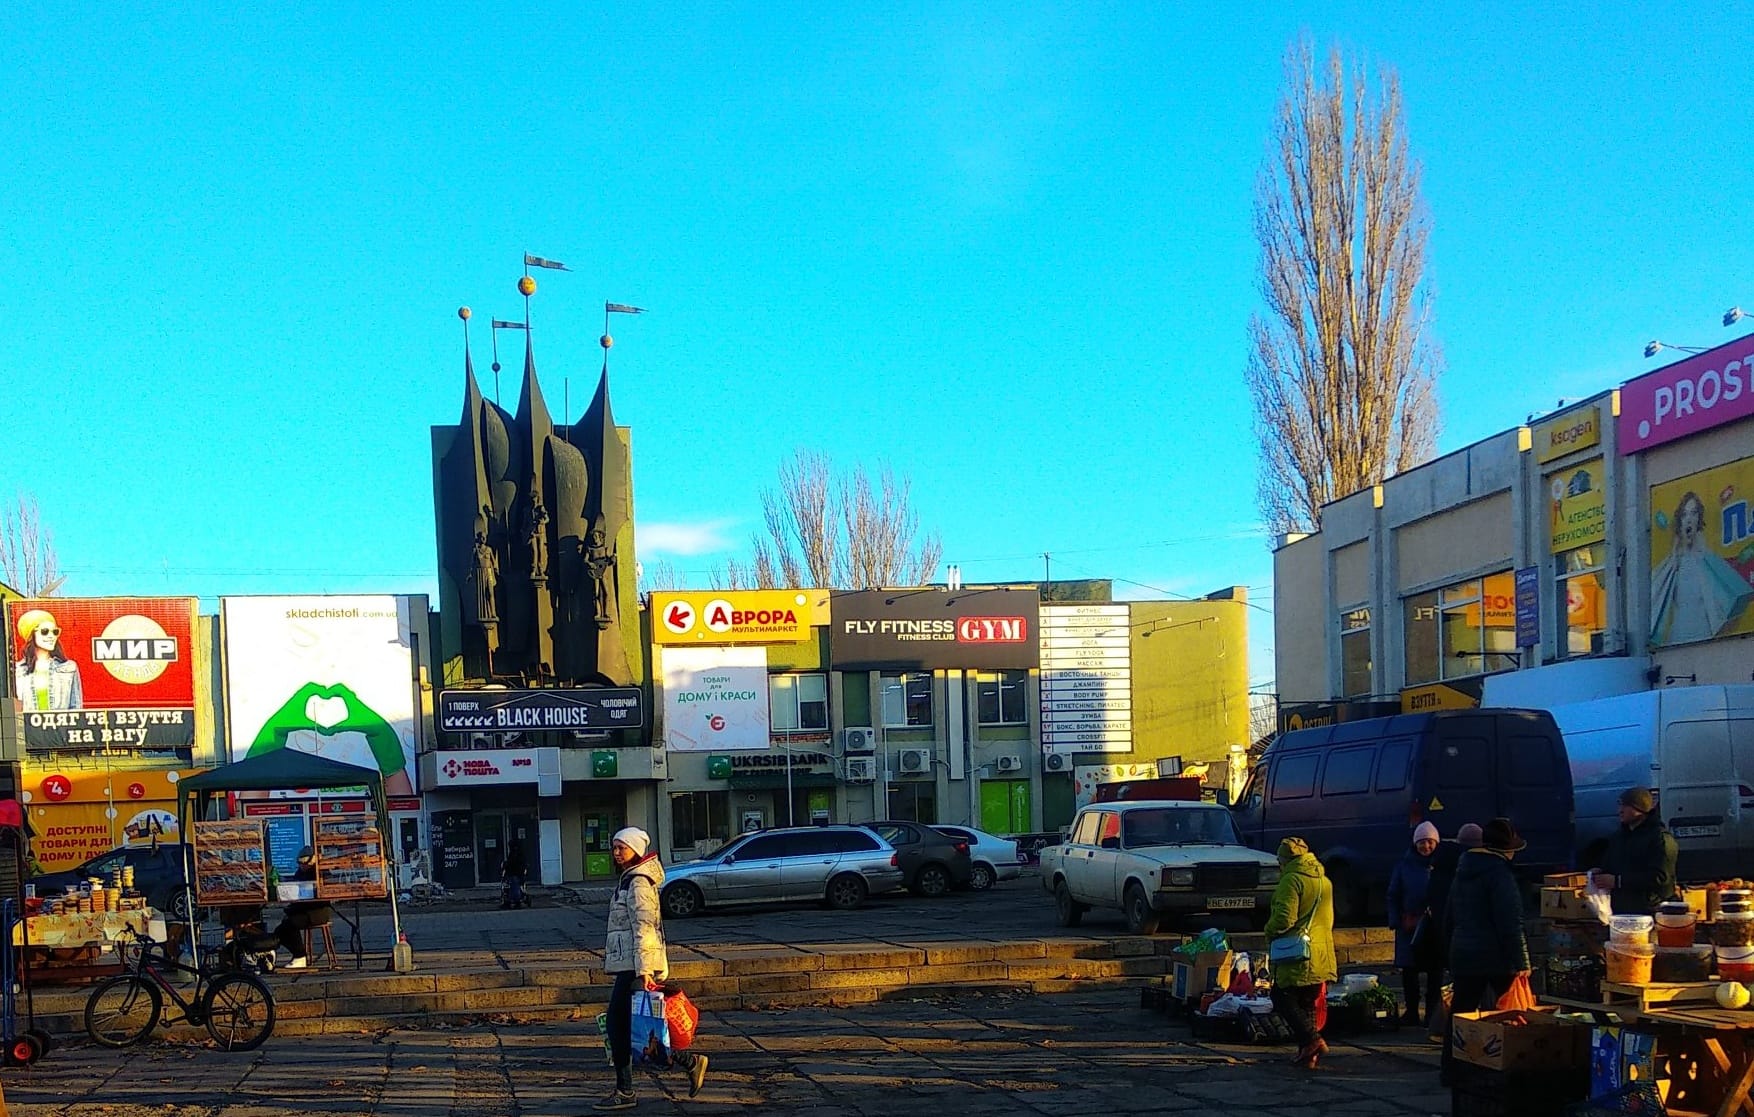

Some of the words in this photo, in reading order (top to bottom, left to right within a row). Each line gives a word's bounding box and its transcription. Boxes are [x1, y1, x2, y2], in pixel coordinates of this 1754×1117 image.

[710, 606, 797, 626] АВРОРА
[731, 626, 798, 634] МУЛЬТИМАРКЕТ
[845, 620, 878, 634] FLY
[881, 620, 955, 634] FITNESS
[961, 619, 1021, 641] GYM
[95, 640, 176, 660] МИР
[702, 676, 731, 684] ТОВАРИ
[600, 697, 638, 708] ЧОЛОВІЧИЙ
[678, 692, 713, 704] ДОМУ
[715, 692, 718, 701] і
[720, 691, 756, 701] КРАСИ
[448, 702, 452, 710] 1
[453, 702, 479, 711] ПОВЕРХ
[30, 712, 79, 729] одяг
[85, 712, 108, 725] та
[115, 711, 183, 728] взуття
[497, 708, 541, 726] BLACK
[544, 707, 589, 725] HOUSE
[610, 709, 628, 719] ОДЯГ
[68, 730, 94, 743] на
[101, 729, 148, 745] вагу
[463, 759, 491, 768] НОВА
[732, 753, 828, 767] UKRSIBBANK
[463, 767, 500, 776] ПОШТА
[46, 825, 107, 837] ДОСТУПНІ
[39, 838, 87, 849] ТОВАРИ
[39, 852, 75, 863] ДОМУ
